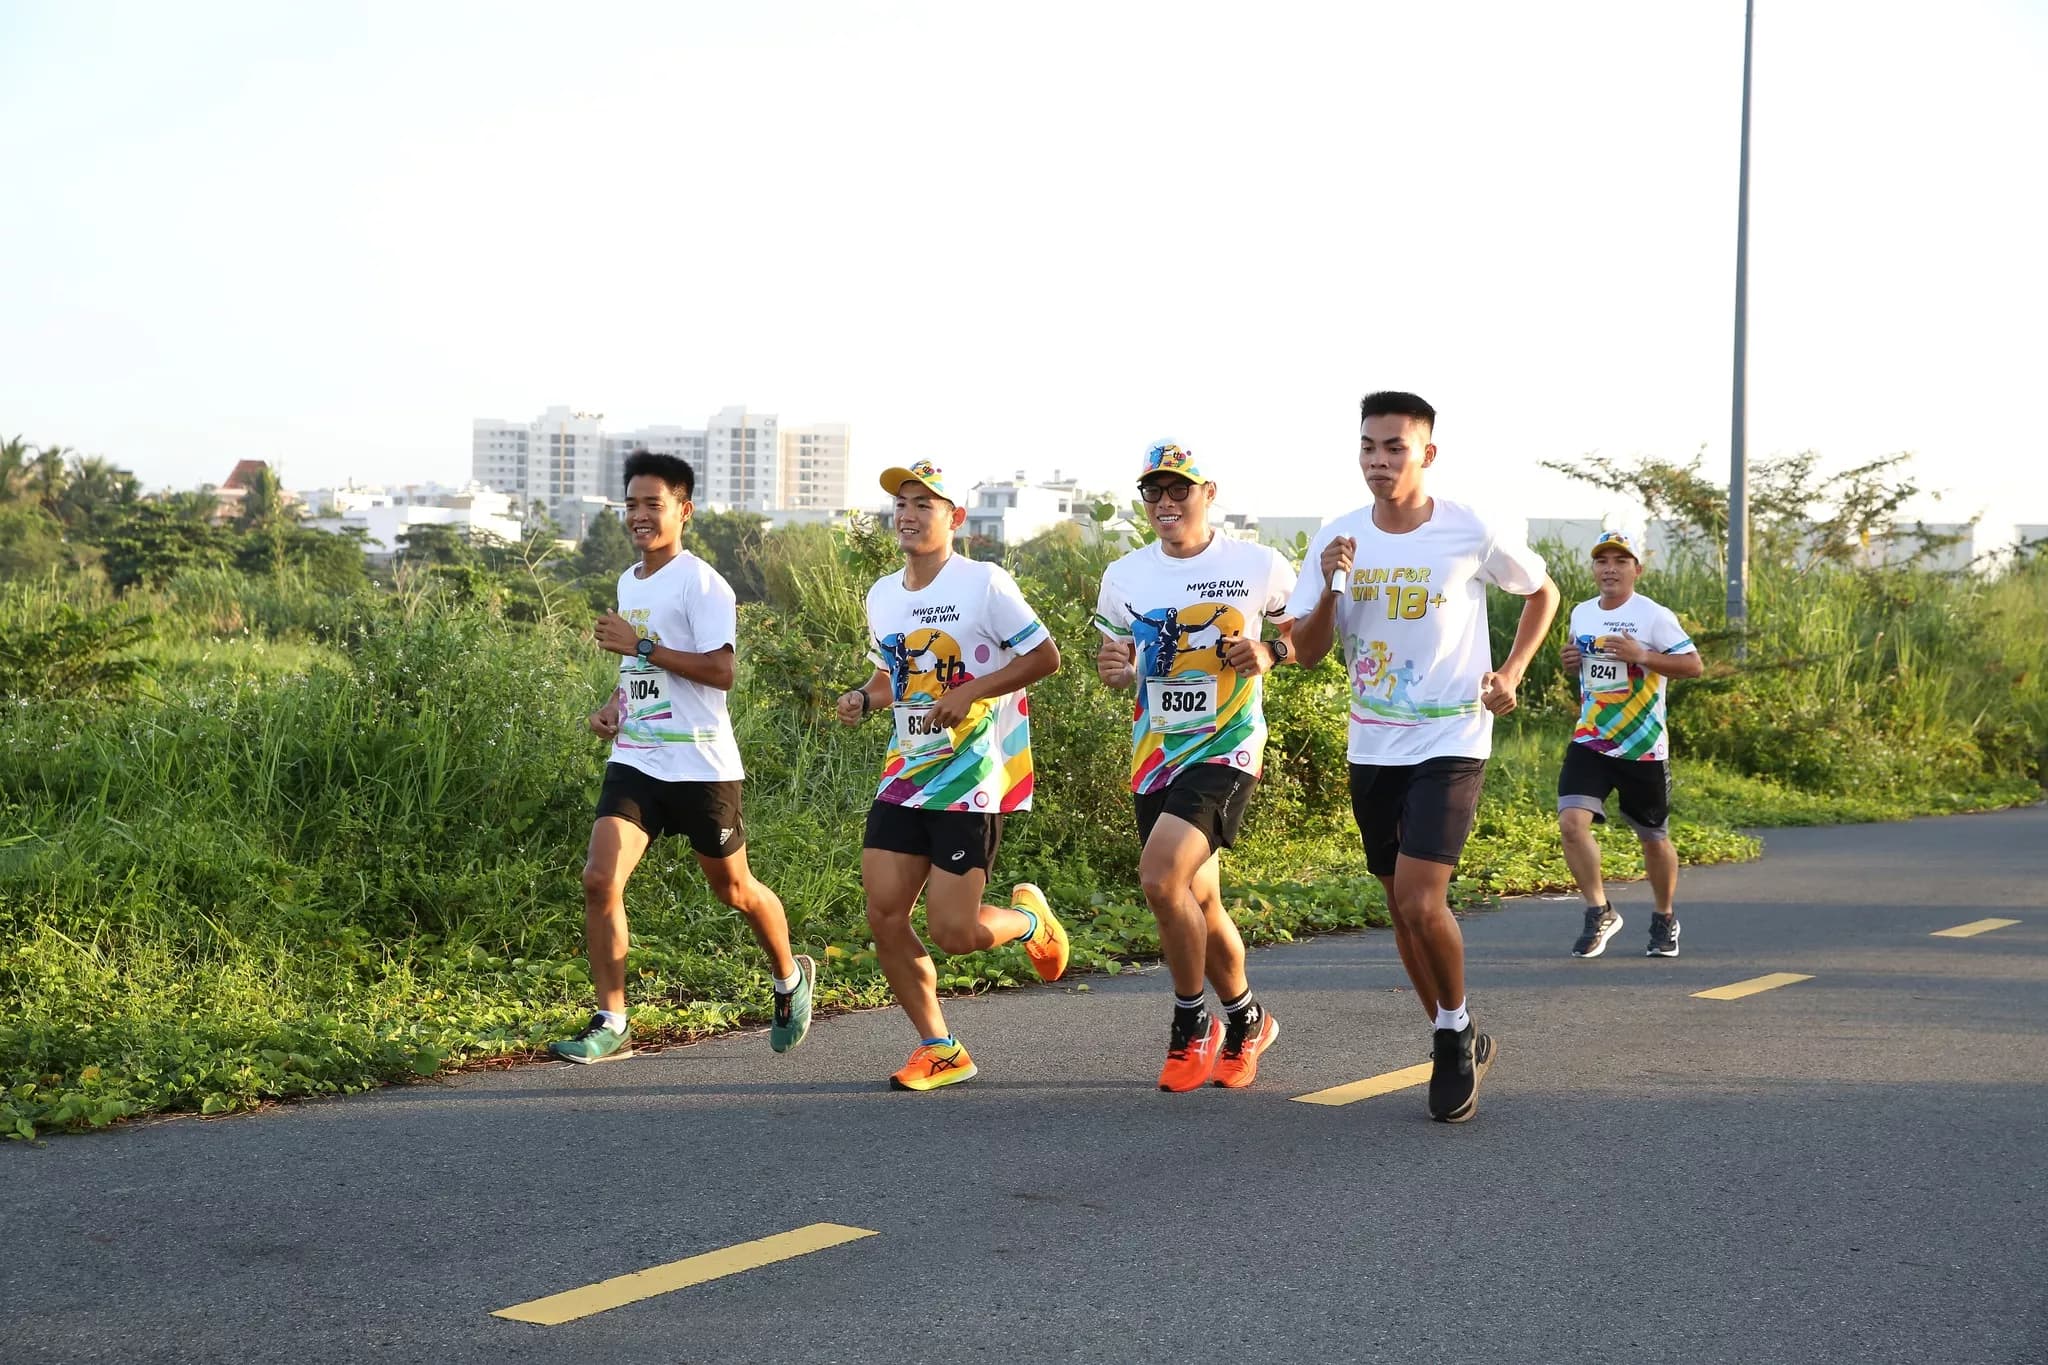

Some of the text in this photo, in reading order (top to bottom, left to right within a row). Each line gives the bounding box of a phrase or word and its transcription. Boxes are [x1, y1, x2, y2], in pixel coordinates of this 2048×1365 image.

[1353, 567, 1432, 584] RUN FOR
[1186, 580, 1244, 591] MWG RUN
[1200, 589, 1249, 598] FOR WIN
[1351, 585, 1379, 602] WIN
[912, 605, 956, 617] MWG RUN
[920, 613, 960, 624] FOR WIN
[935, 655, 965, 682] th
[1591, 664, 1617, 680] 8241
[1162, 691, 1207, 712] 8302
